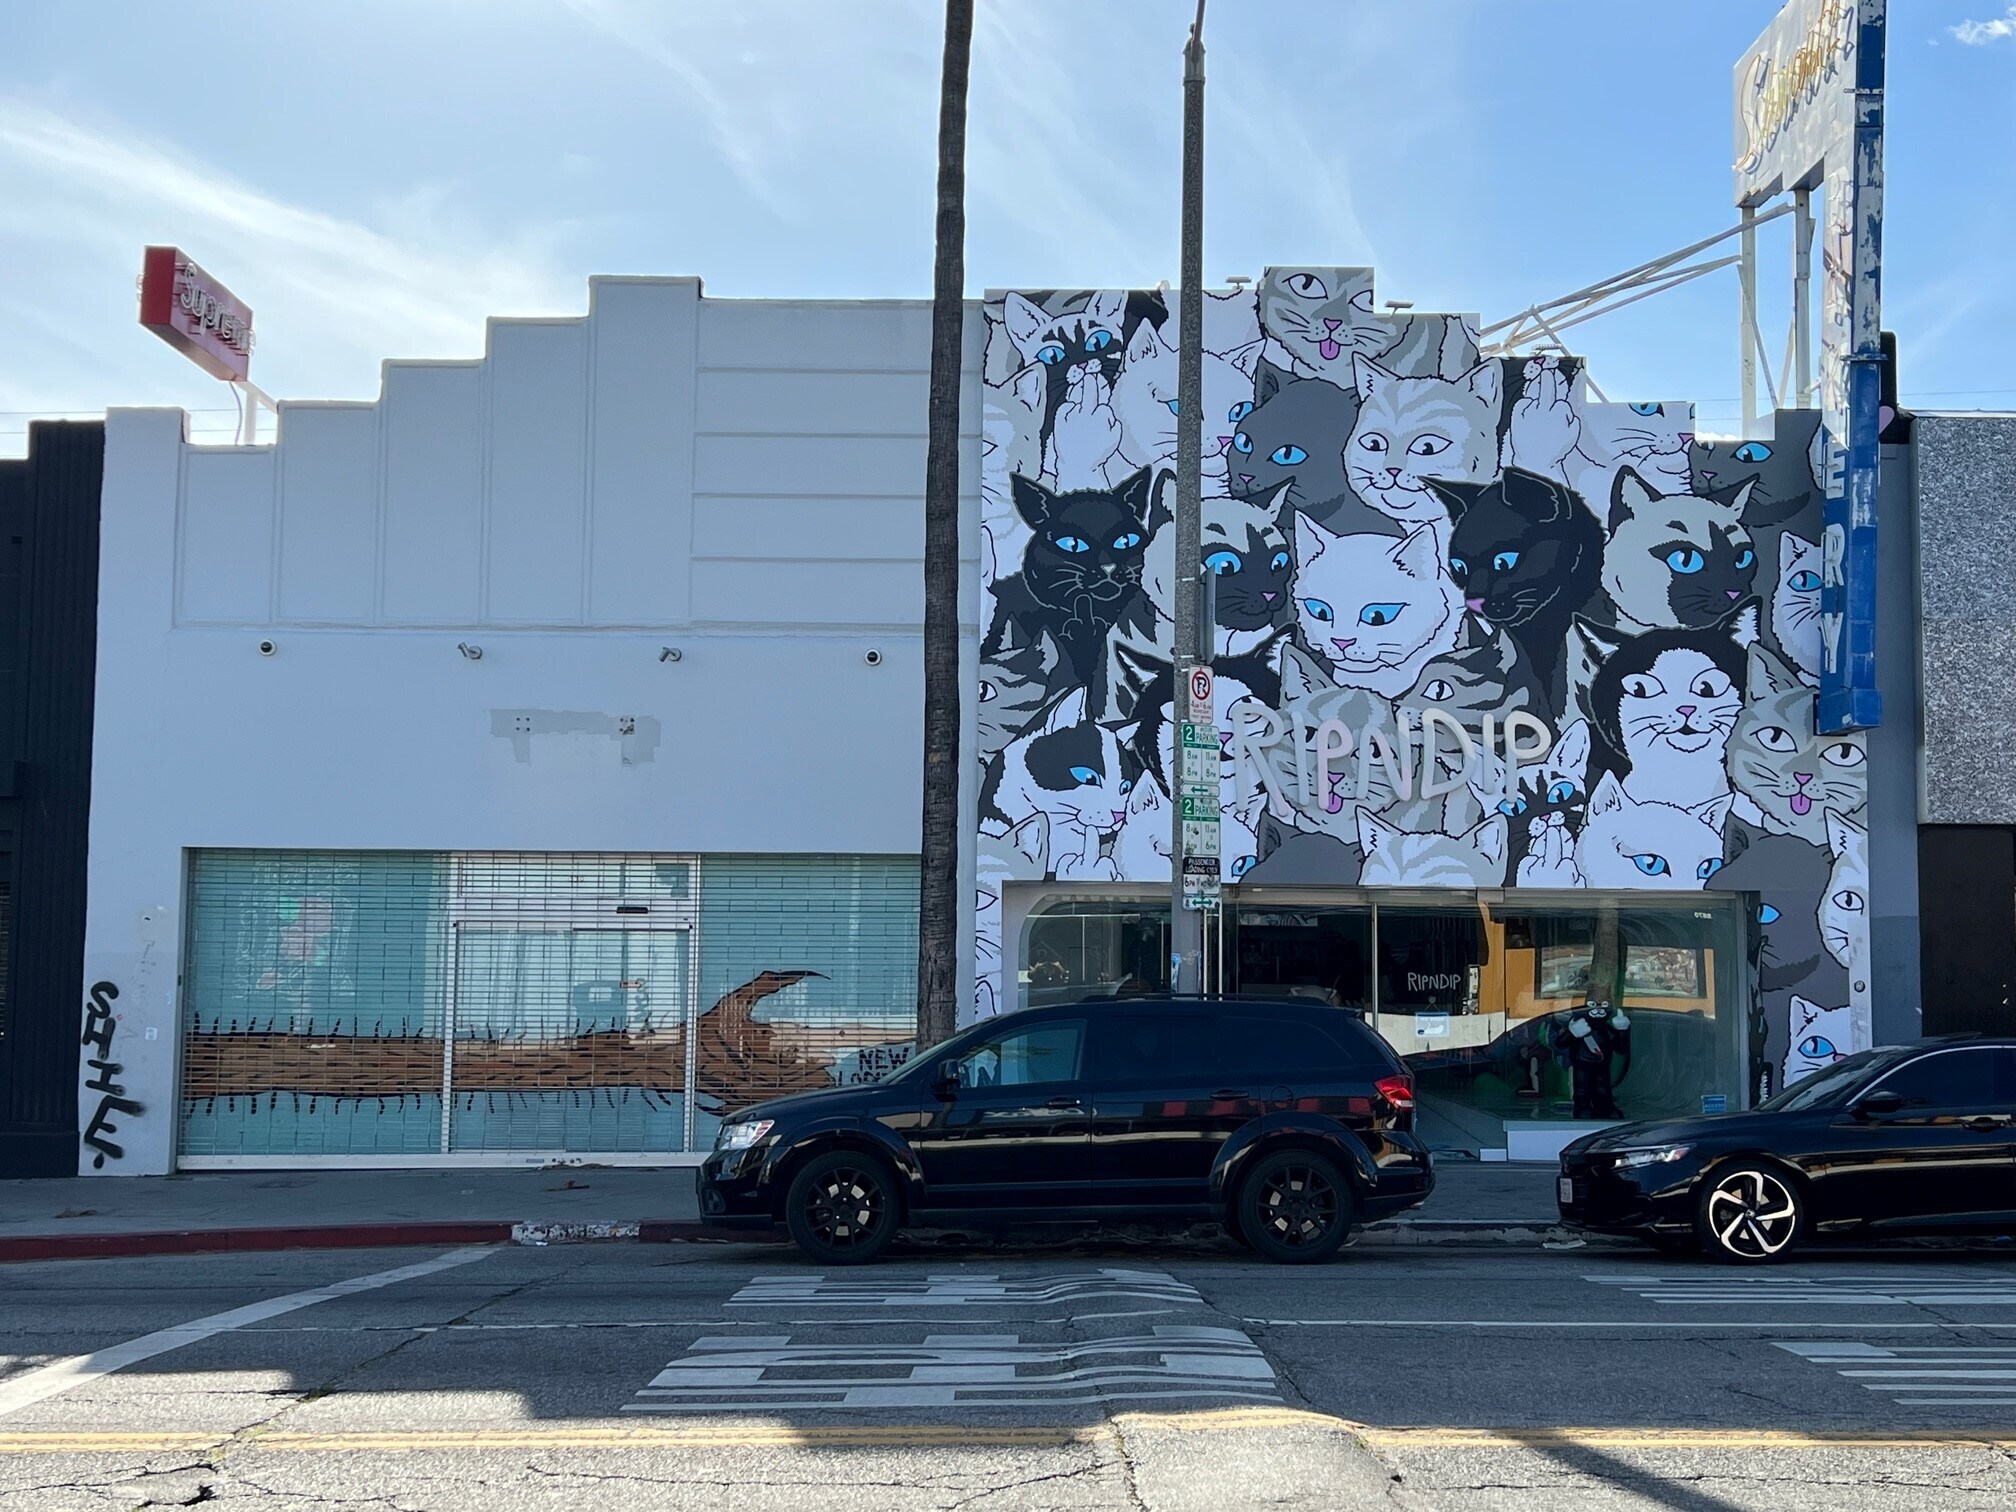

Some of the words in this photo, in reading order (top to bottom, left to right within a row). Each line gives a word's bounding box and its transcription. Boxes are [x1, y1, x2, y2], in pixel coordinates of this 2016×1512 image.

[1185, 726, 1193, 741] 2
[1196, 733, 1218, 744] PARKING
[1231, 698, 1552, 816] RIPNDIP
[1184, 798, 1192, 813] 2
[1195, 805, 1218, 816] PARKING
[1407, 972, 1461, 992] RIPNDIP
[859, 1047, 910, 1071] NEW
